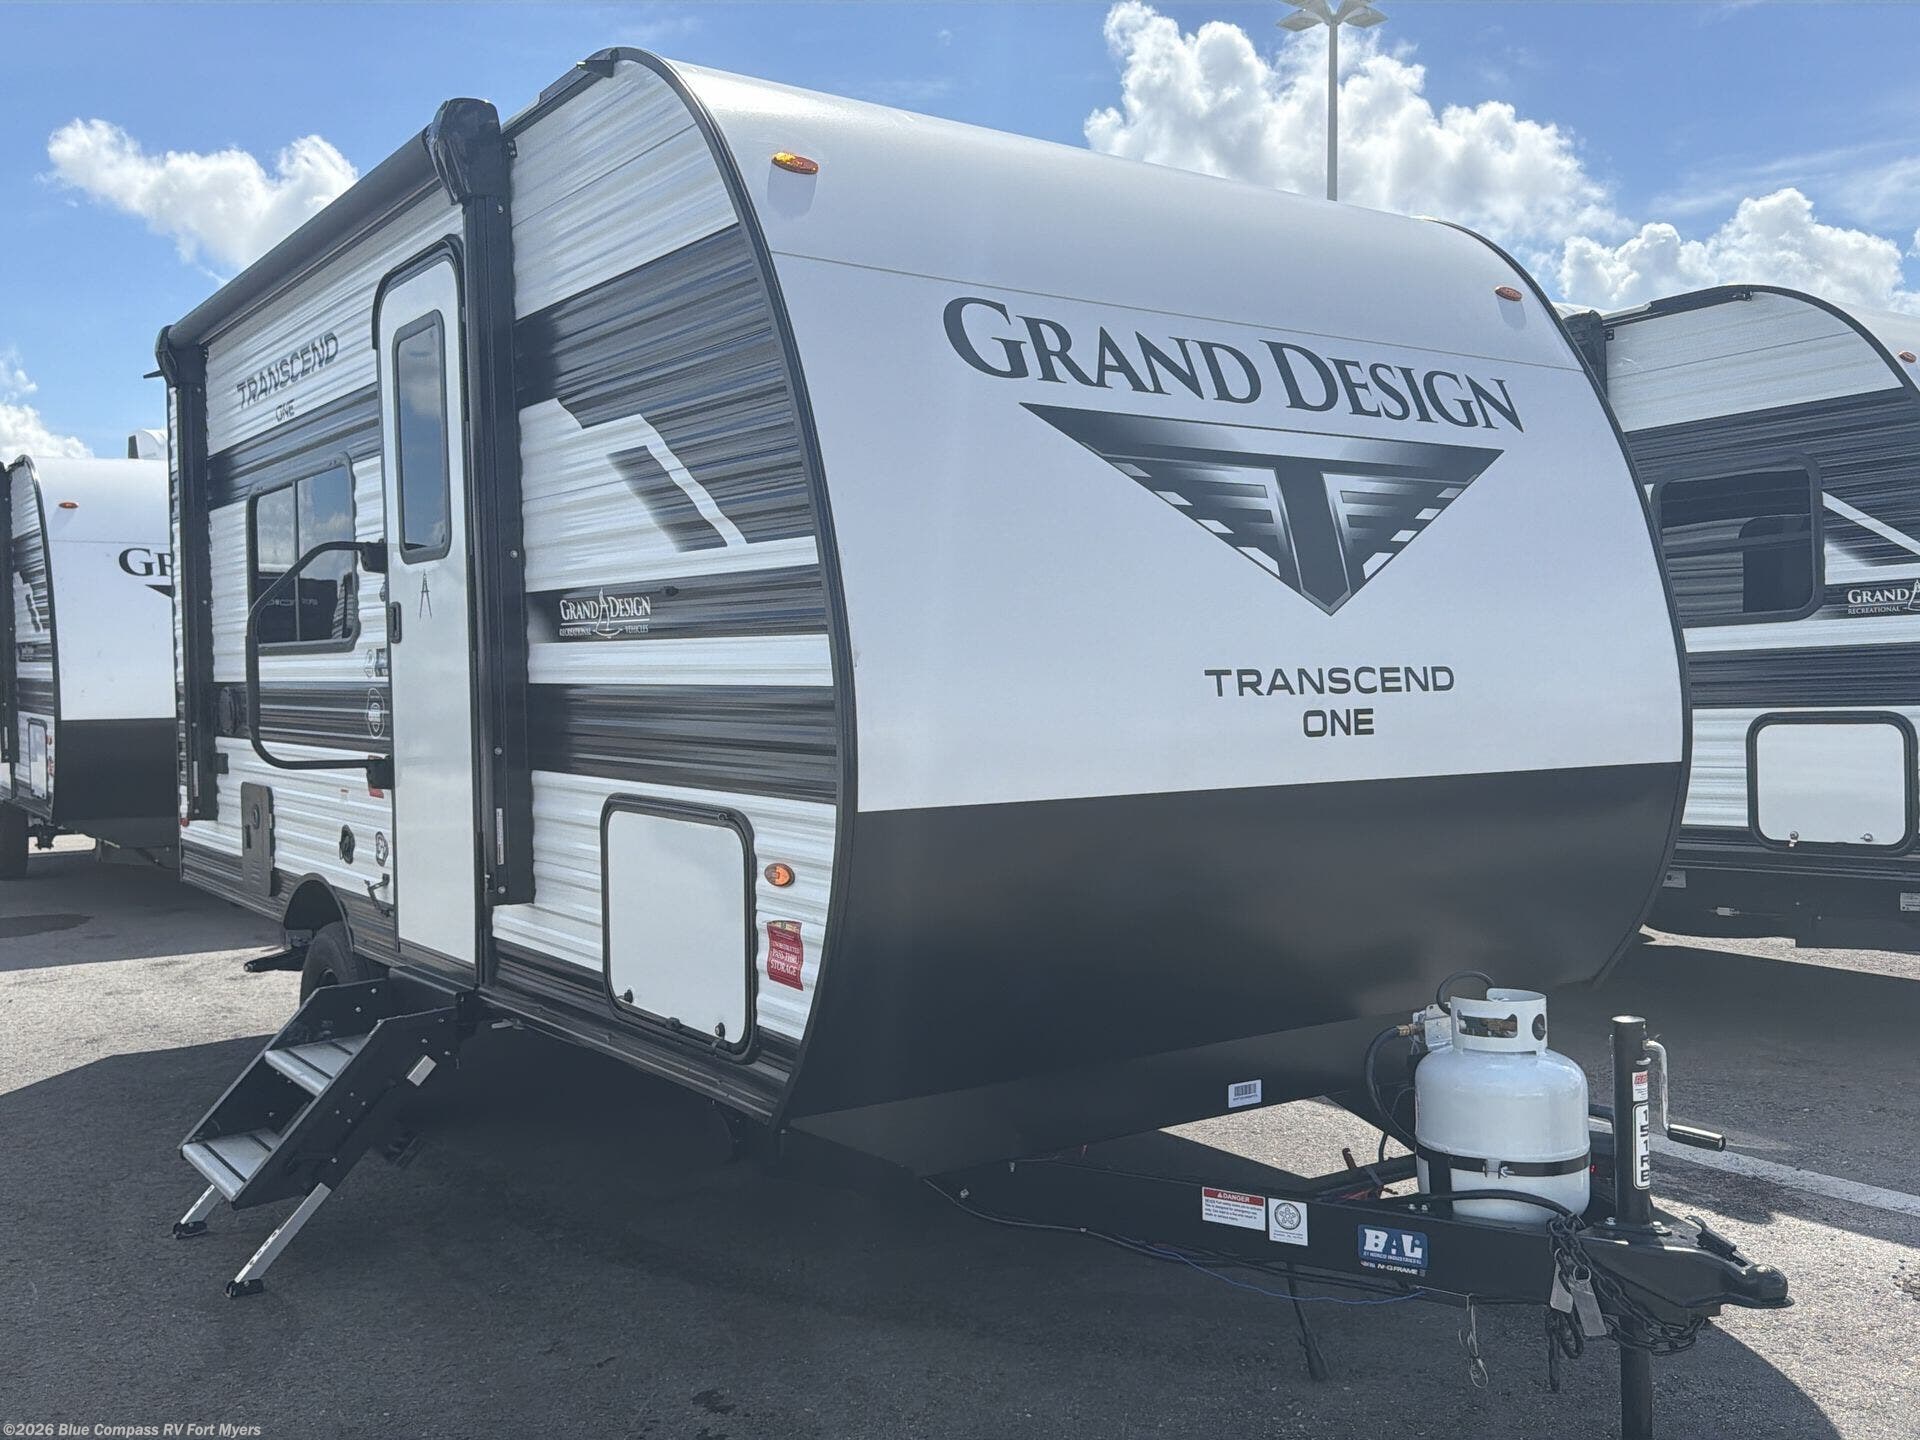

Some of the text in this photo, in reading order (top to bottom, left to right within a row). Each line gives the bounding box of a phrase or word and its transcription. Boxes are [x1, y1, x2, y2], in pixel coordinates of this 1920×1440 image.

[236, 331, 339, 409] TRANSCEND
[942, 296, 1524, 433] GRAND DESIGN
[275, 399, 296, 422] ONE
[559, 595, 652, 621] GRAND DESIGN
[1847, 588, 1910, 604] GRAND
[1847, 605, 1901, 615] RECREATIONAL
[624, 624, 649, 634] VEHICLES
[1203, 665, 1455, 698] TRANSCEND
[1302, 707, 1375, 738] ONE
[770, 958, 798, 976] STORAGE
[1222, 1192, 1251, 1203] DANGER
[1363, 1228, 1423, 1259] BAL
